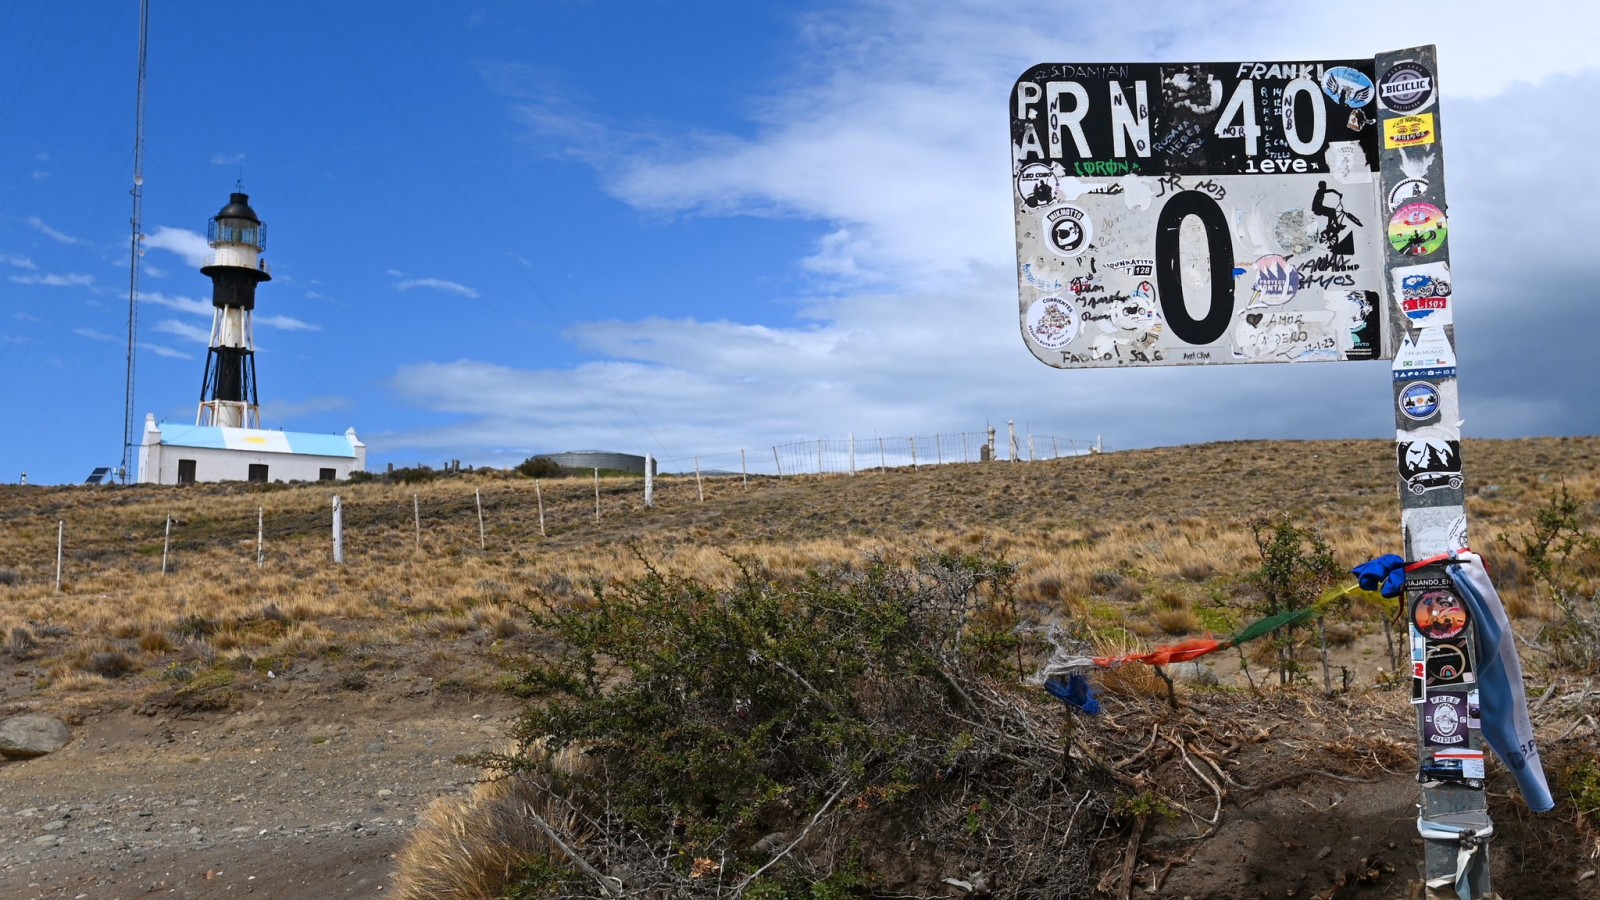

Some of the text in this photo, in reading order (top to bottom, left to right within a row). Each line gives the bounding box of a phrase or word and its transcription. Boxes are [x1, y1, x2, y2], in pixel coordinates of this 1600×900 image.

[1386, 80, 1426, 94] BICICLIC
[1215, 79, 1326, 155] 40
[1195, 179, 1227, 201] NOB
[1135, 267, 1151, 275] 128
[1155, 190, 1234, 345] 0
[1042, 297, 1074, 313] CORRIENTES
